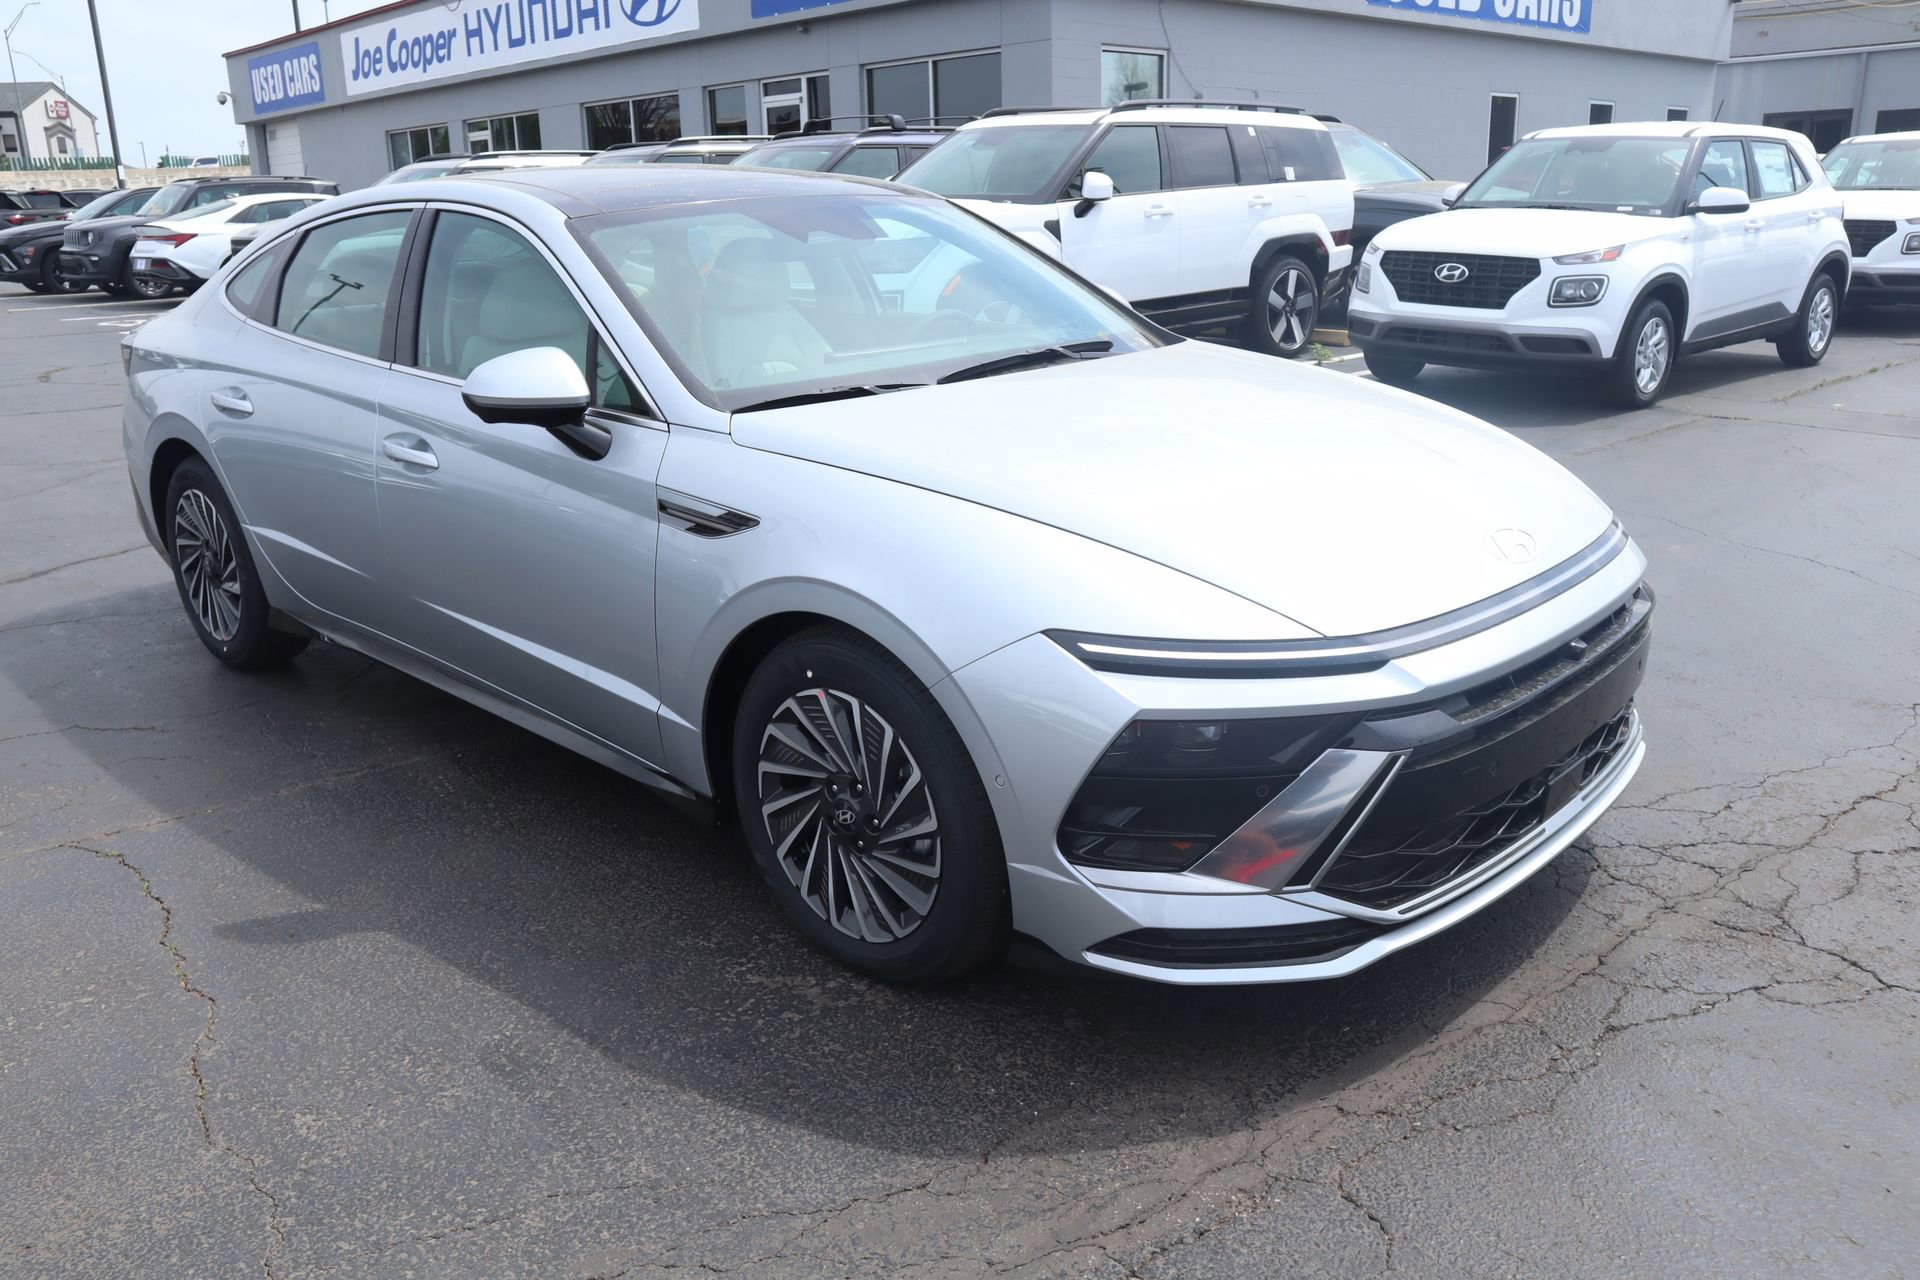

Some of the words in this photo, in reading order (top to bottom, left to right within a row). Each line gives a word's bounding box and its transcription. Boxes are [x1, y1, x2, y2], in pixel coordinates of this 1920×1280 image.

[352, 37, 383, 81] Joe
[386, 28, 457, 73] Cooper
[463, 0, 611, 57] HYUNDAI
[251, 64, 284, 104] USED
[284, 54, 320, 97] CARS
